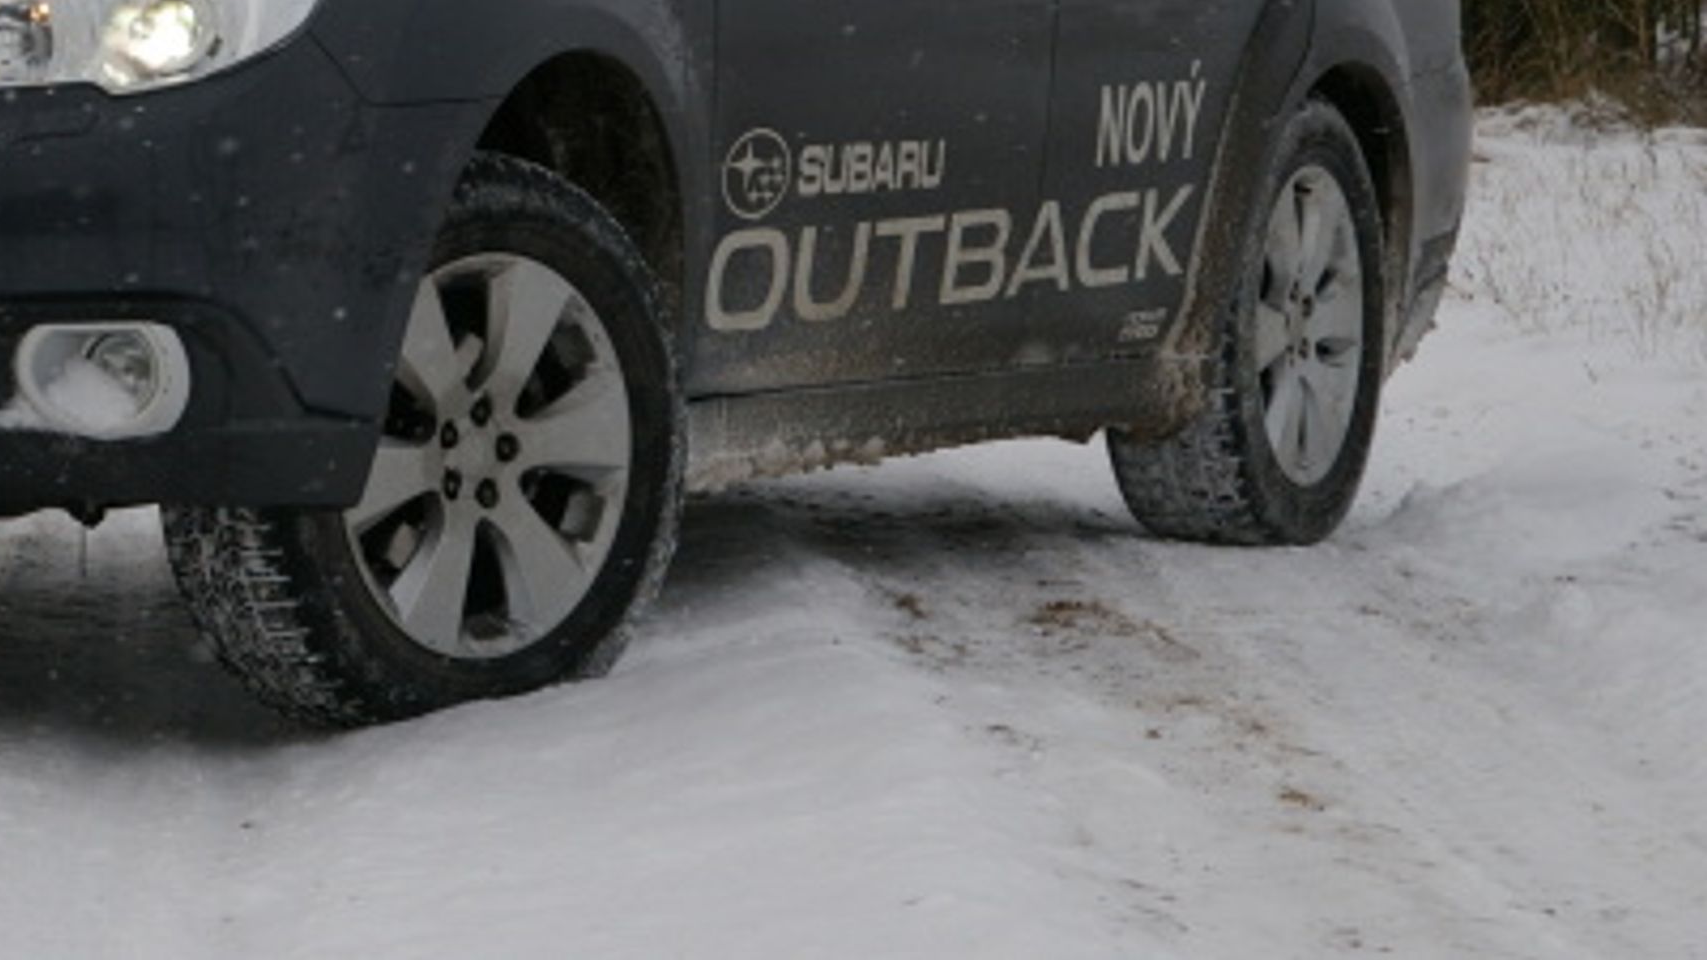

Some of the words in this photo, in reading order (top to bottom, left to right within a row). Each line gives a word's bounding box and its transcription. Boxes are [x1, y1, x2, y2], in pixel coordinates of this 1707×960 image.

[798, 139, 946, 197] SUBARU
[1096, 59, 1206, 168] NOVÝ
[704, 183, 1196, 332] OUTBACK
